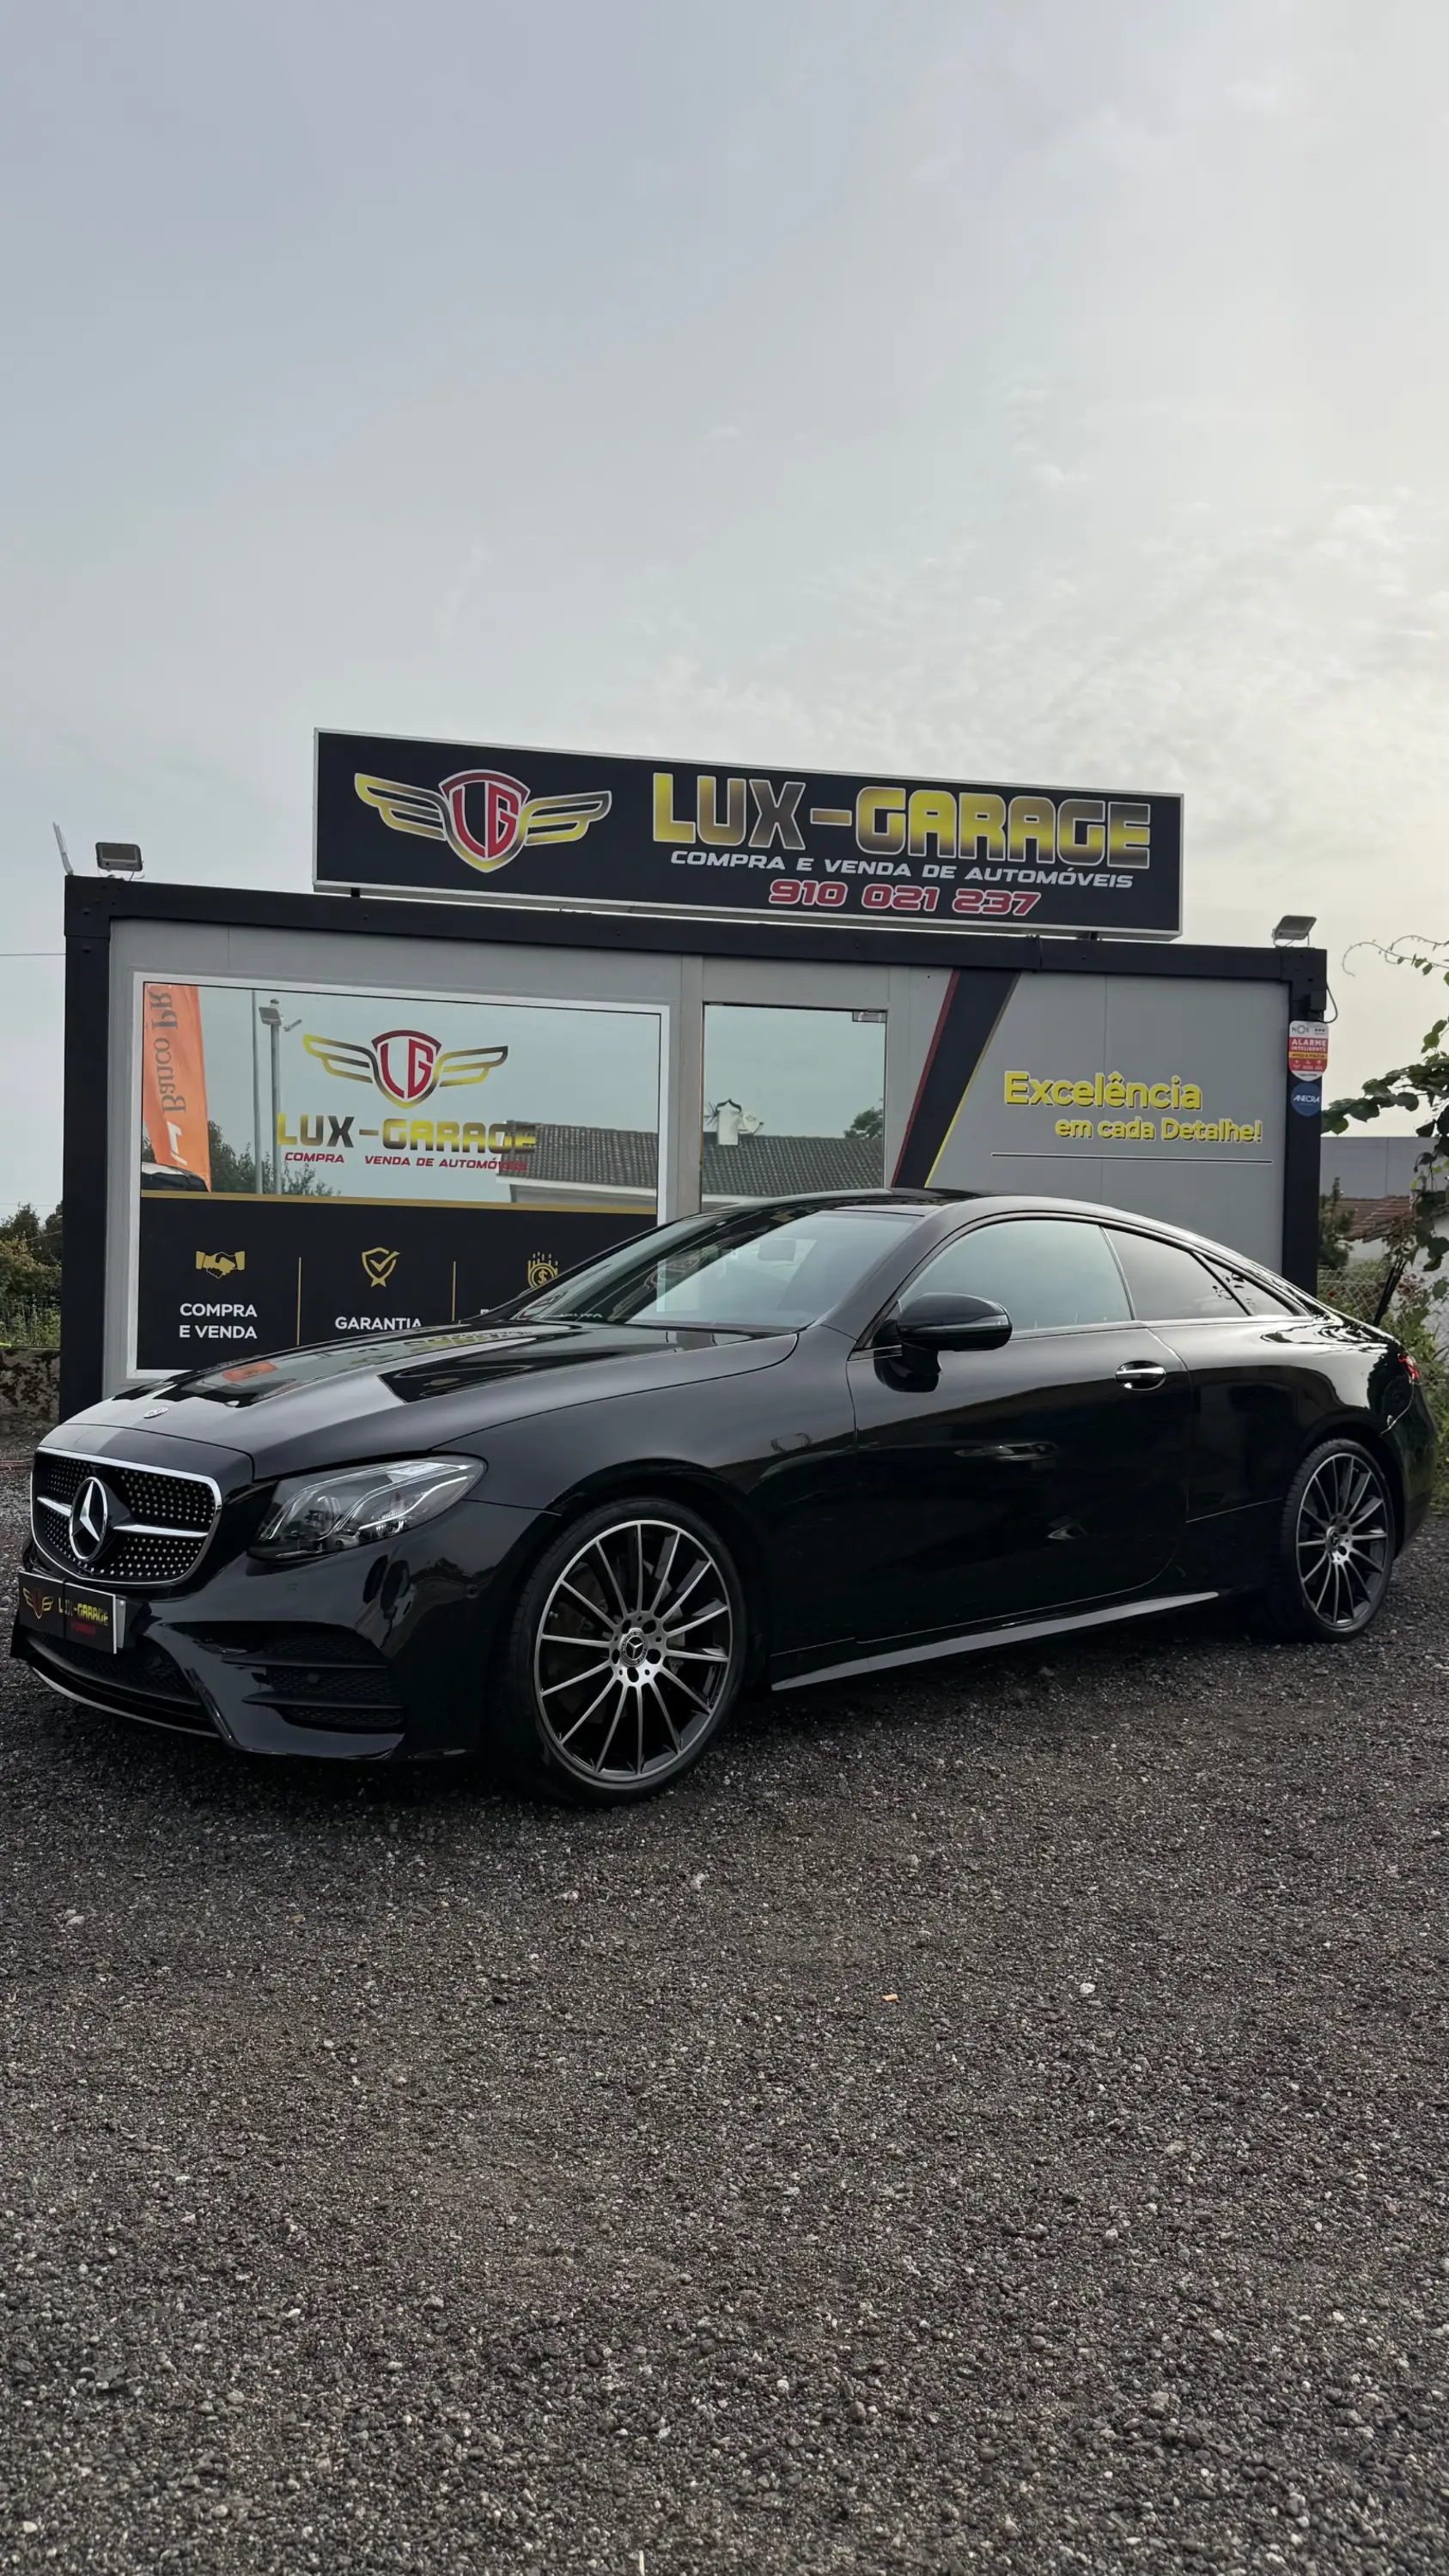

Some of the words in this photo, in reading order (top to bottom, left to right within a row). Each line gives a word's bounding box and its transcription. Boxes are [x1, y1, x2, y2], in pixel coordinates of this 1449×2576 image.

[652, 772, 1152, 869] LUX-GARAGE
[670, 850, 785, 871] COMPRA
[795, 858, 814, 872] E
[824, 859, 912, 878] VENDA
[922, 864, 956, 880] DE
[965, 866, 1134, 889] AUTOMÓVEIS
[768, 879, 848, 908] 910
[861, 883, 941, 911] 021
[952, 888, 1042, 916] 237
[1291, 1038, 1326, 1047] ALARME
[1003, 1070, 1202, 1110] Excelência
[276, 1114, 536, 1155] LUX-GARAGE
[1055, 1118, 1093, 1139] em
[1097, 1116, 1154, 1141] cada
[1160, 1118, 1263, 1145] Detalhe!
[284, 1151, 344, 1163] COMPRA
[364, 1156, 411, 1167] VENDA
[416, 1157, 435, 1167] DE
[439, 1157, 527, 1172] AUTOMÓVEIS
[180, 1303, 258, 1317] COMPRA
[335, 1316, 423, 1330] GARANTIA
[179, 1324, 191, 1338] E
[194, 1325, 258, 1339] VENDA
